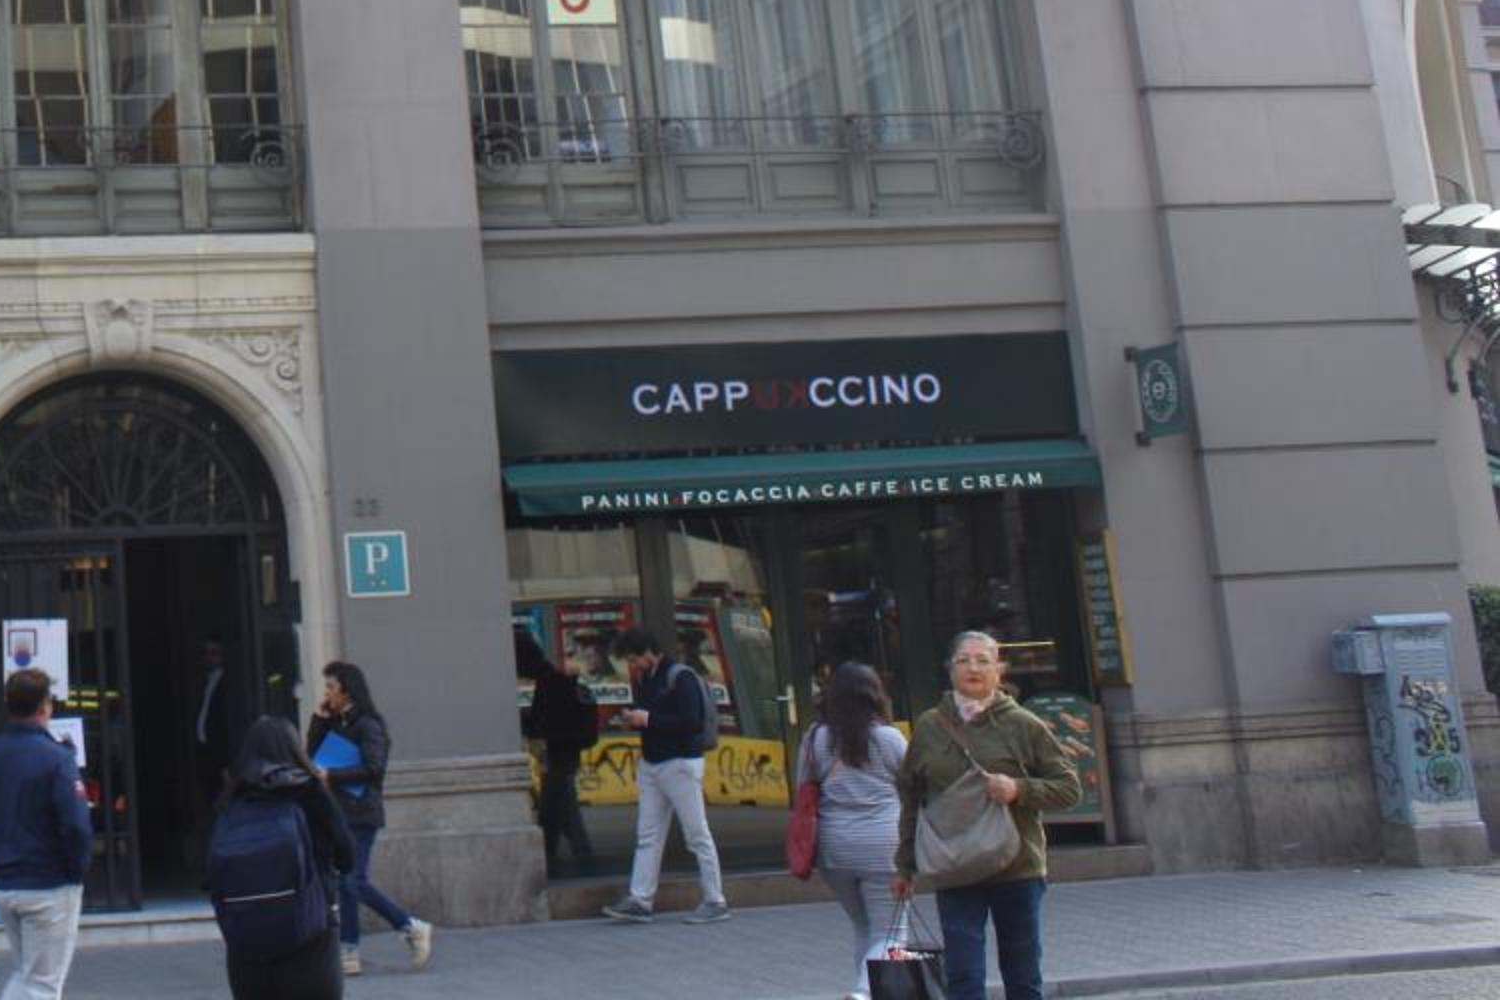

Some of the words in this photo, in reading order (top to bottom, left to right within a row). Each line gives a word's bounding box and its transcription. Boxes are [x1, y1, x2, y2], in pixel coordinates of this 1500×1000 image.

[581, 492, 670, 511] PANINI
[681, 484, 811, 504] FOCACCIA
[820, 480, 899, 498] CAFFE
[911, 477, 950, 493] ICE
[960, 471, 1044, 490] CREAM
[365, 541, 388, 575] P
